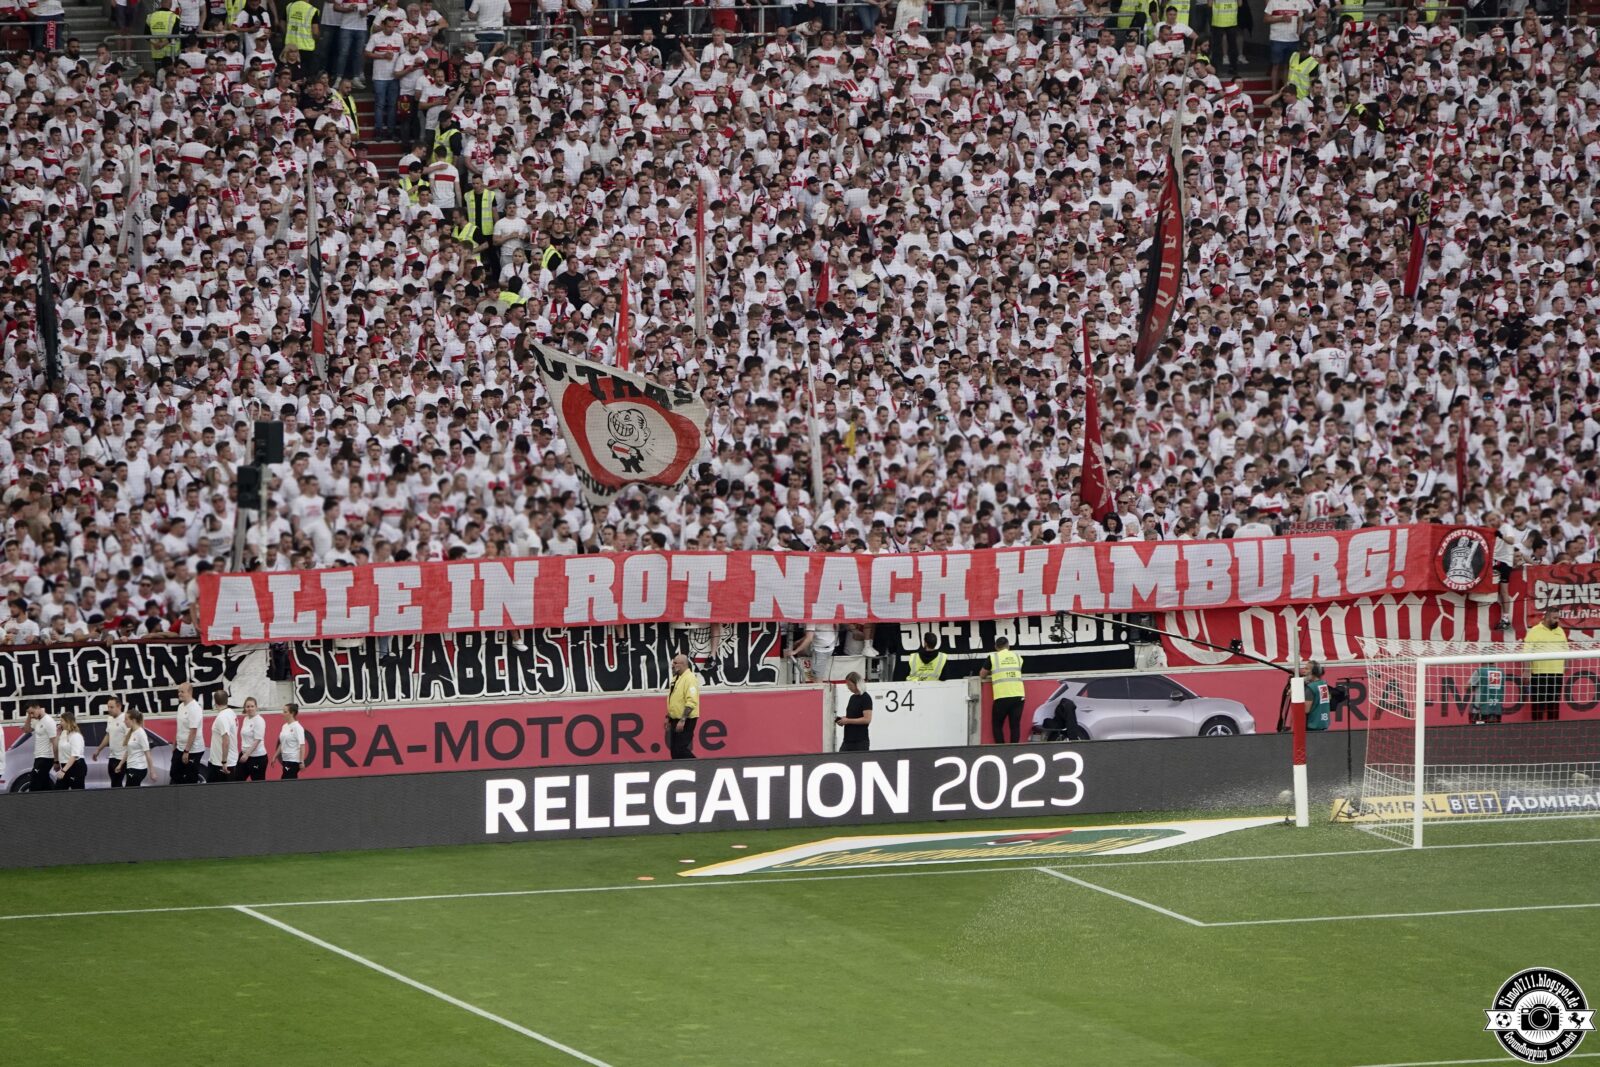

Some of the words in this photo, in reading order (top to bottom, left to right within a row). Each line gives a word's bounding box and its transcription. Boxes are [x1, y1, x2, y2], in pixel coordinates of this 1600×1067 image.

[207, 566, 423, 642] ALLE
[447, 560, 539, 631] IN
[563, 553, 726, 624] ROT
[749, 553, 972, 620] NACH
[994, 528, 1410, 617] HAMBURG!
[1534, 579, 1600, 610] SZENE
[885, 690, 915, 713] 34
[483, 759, 911, 835] RELEGATION
[932, 751, 1086, 812] 2023
[1450, 796, 1494, 811] BET
